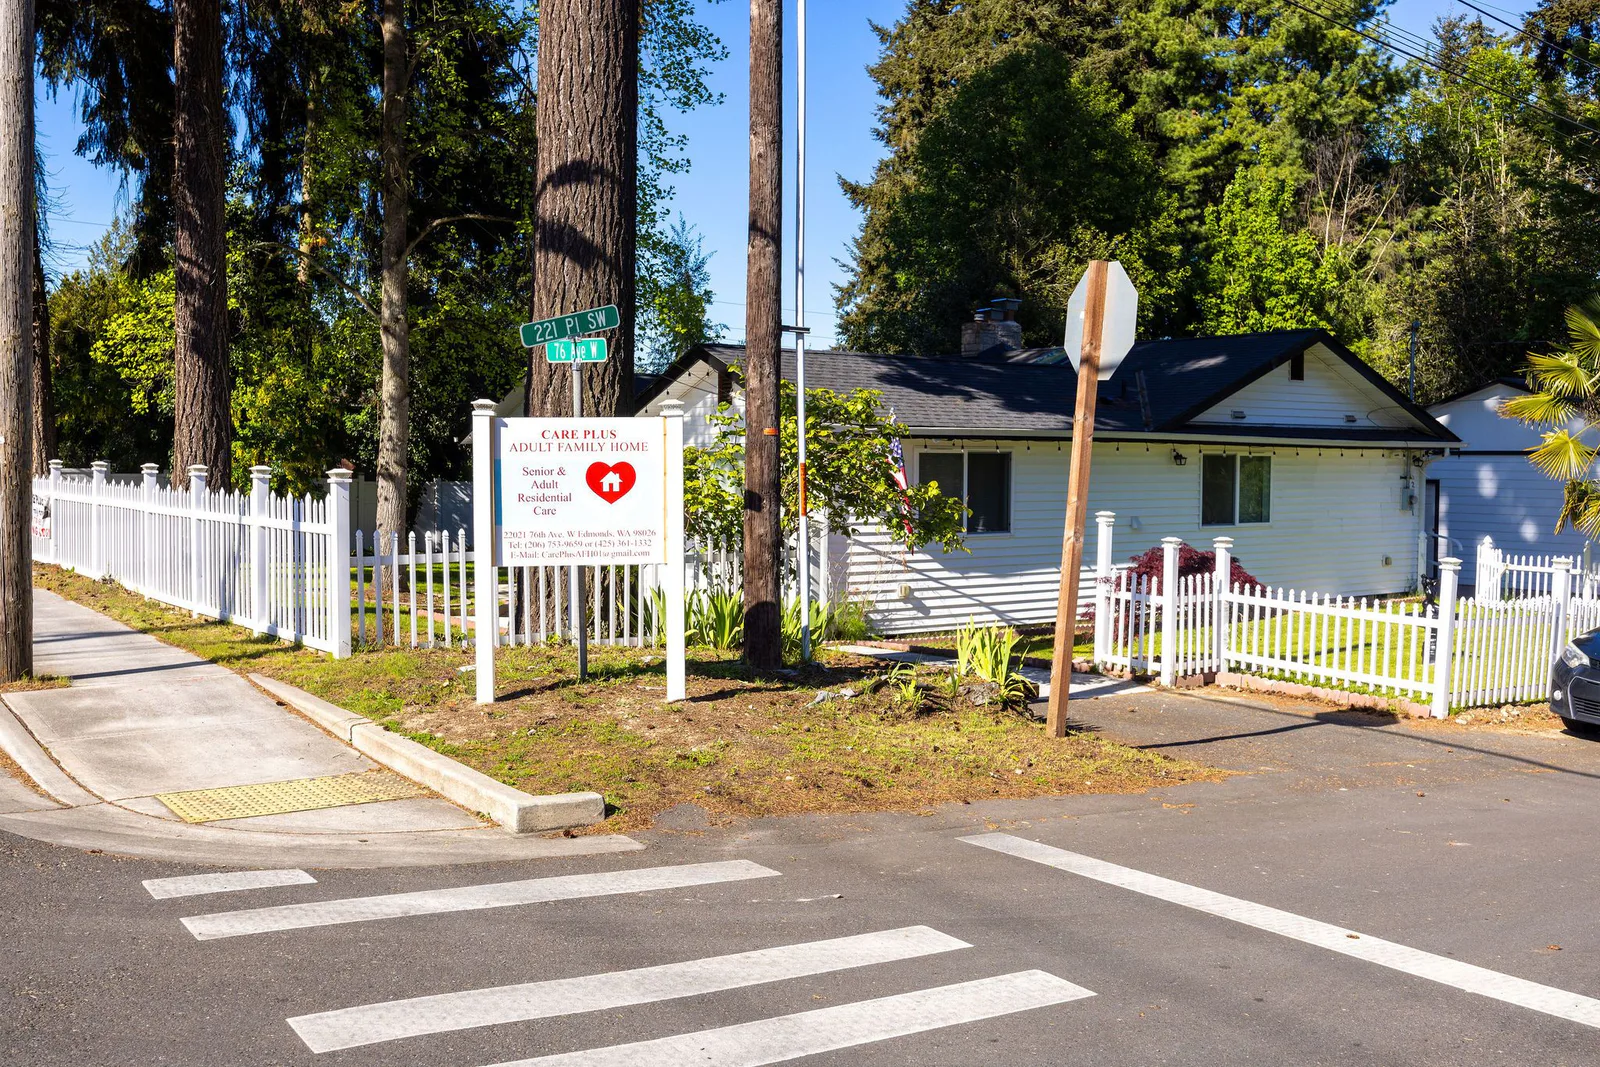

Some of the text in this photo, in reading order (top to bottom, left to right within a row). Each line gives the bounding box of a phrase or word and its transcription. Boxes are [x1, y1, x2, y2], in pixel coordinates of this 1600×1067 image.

[534, 323, 558, 342] 221
[587, 310, 606, 329] SW
[554, 344, 566, 360] 76
[590, 341, 598, 359] W
[541, 429, 617, 440] CARE PLUS
[509, 441, 649, 453] ADULT FAMILY HOME
[522, 467, 566, 477] Senior &
[531, 480, 559, 490] Adult
[517, 493, 572, 503] Residential
[533, 506, 557, 516] Care
[503, 531, 526, 539] 22021
[529, 531, 546, 539] 76th
[567, 530, 576, 538] W
[617, 529, 631, 537] WA
[633, 529, 656, 537] 98026
[508, 541, 522, 549] Tel:
[524, 541, 546, 549] (206)
[594, 540, 615, 548] (425)
